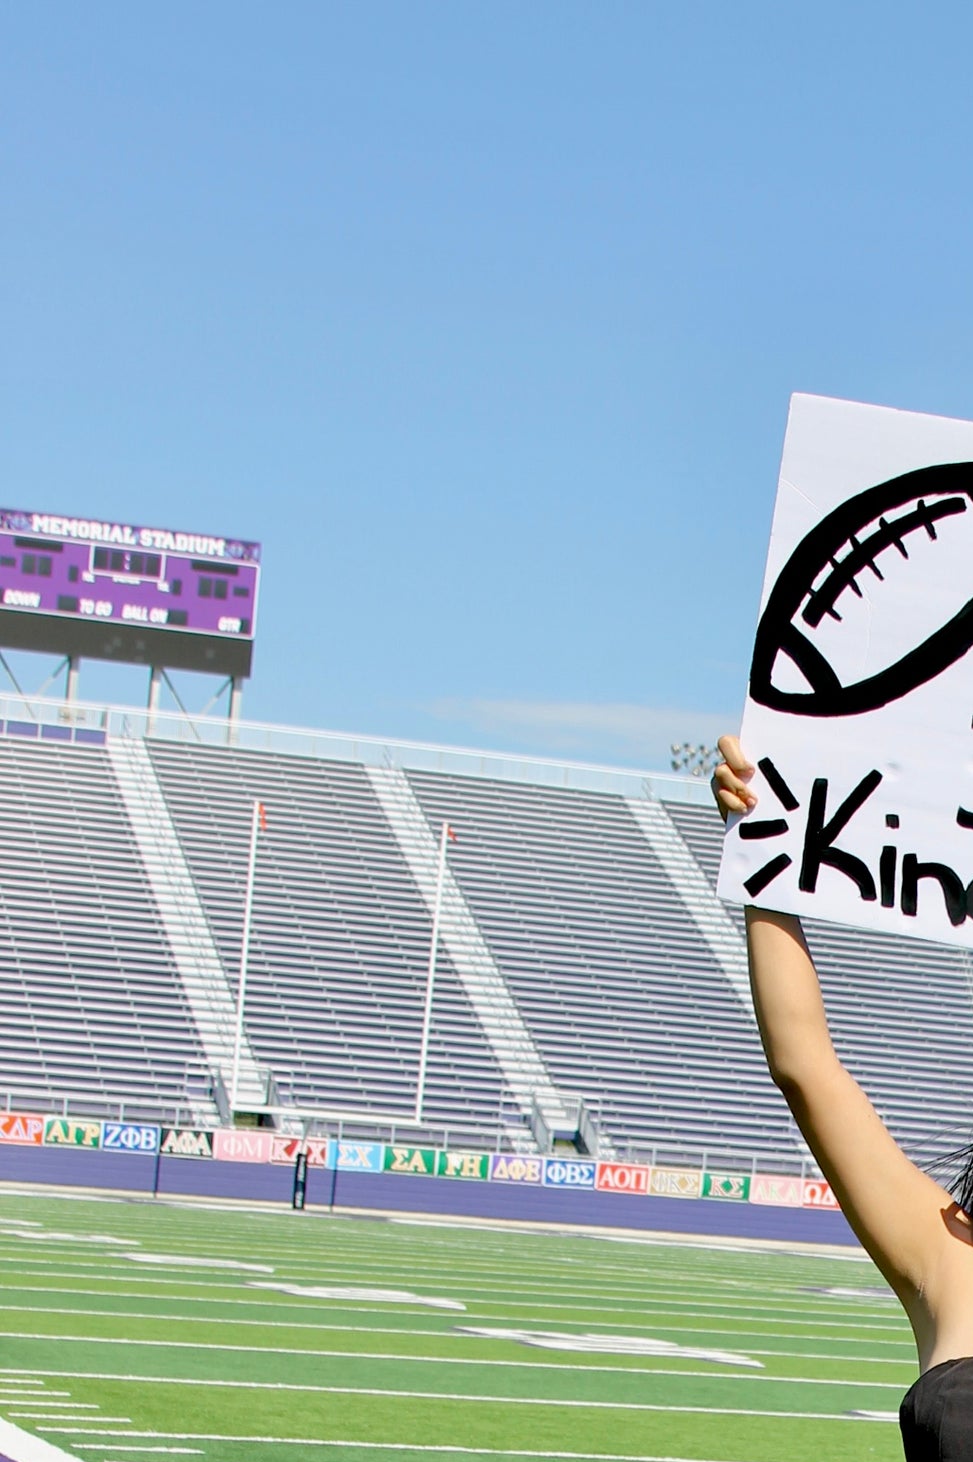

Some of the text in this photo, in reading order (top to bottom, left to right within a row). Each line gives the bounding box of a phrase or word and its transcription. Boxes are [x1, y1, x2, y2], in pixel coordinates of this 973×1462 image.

[32, 514, 226, 557] MEMORIAL STADIUM
[3, 589, 40, 608] DOWN
[80, 598, 94, 614] TO
[122, 604, 148, 621] BALL
